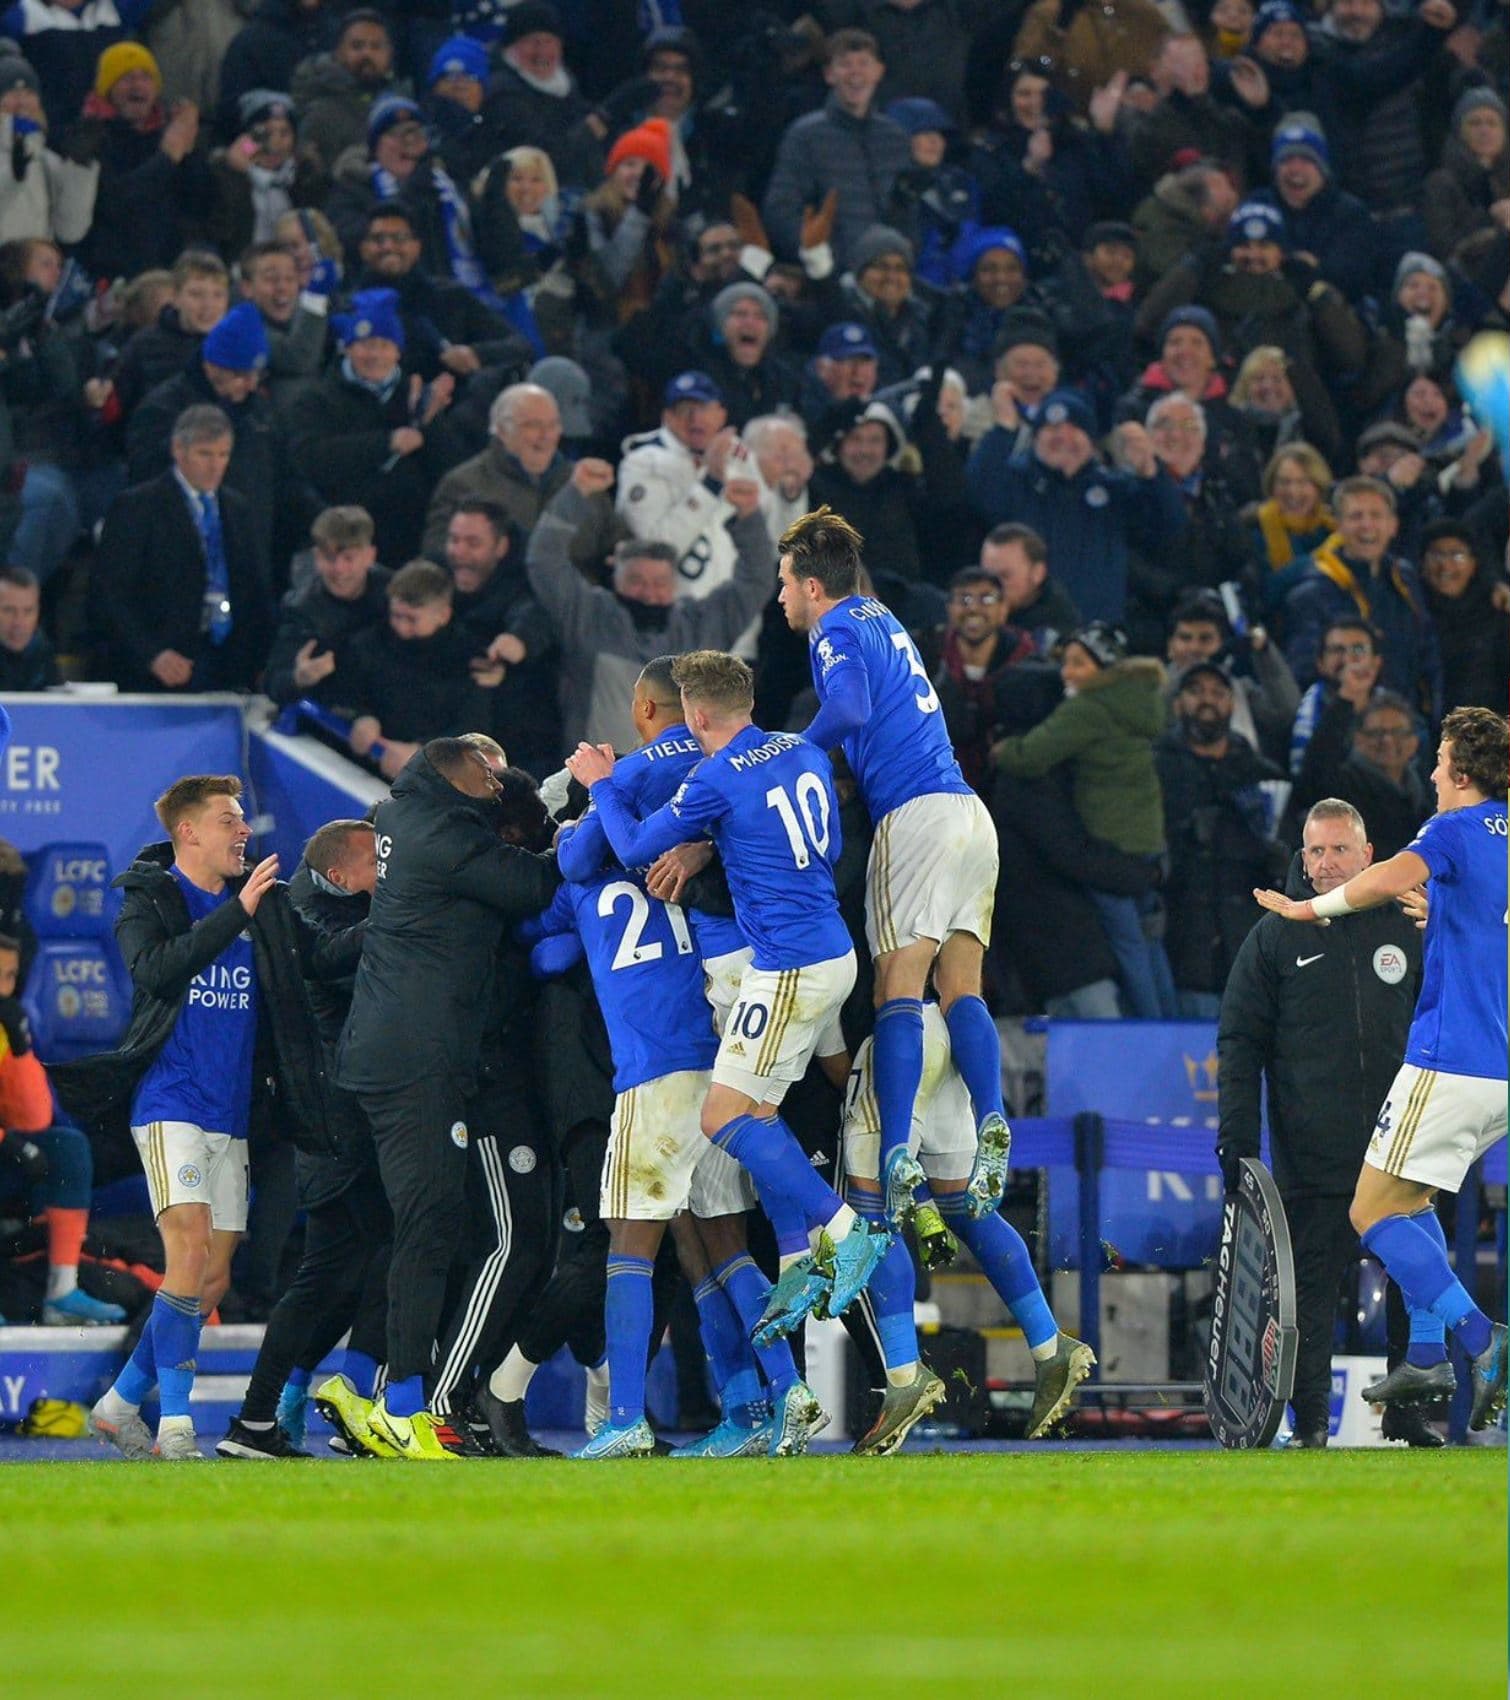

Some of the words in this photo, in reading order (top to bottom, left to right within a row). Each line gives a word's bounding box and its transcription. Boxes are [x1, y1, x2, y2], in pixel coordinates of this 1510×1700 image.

[890, 631, 941, 714] 3
[642, 738, 699, 762] TIELE
[7, 747, 60, 791] ER
[766, 771, 831, 870] 10
[1484, 814, 1508, 836] SÖ
[375, 833, 393, 859] NG
[55, 860, 106, 883] LCFC
[597, 881, 694, 971] 21
[55, 960, 106, 983] LCFC
[1381, 953, 1401, 966] EA
[188, 988, 250, 1010] POWER
[731, 1001, 768, 1040] 10
[0, 1375, 26, 1413] Y
